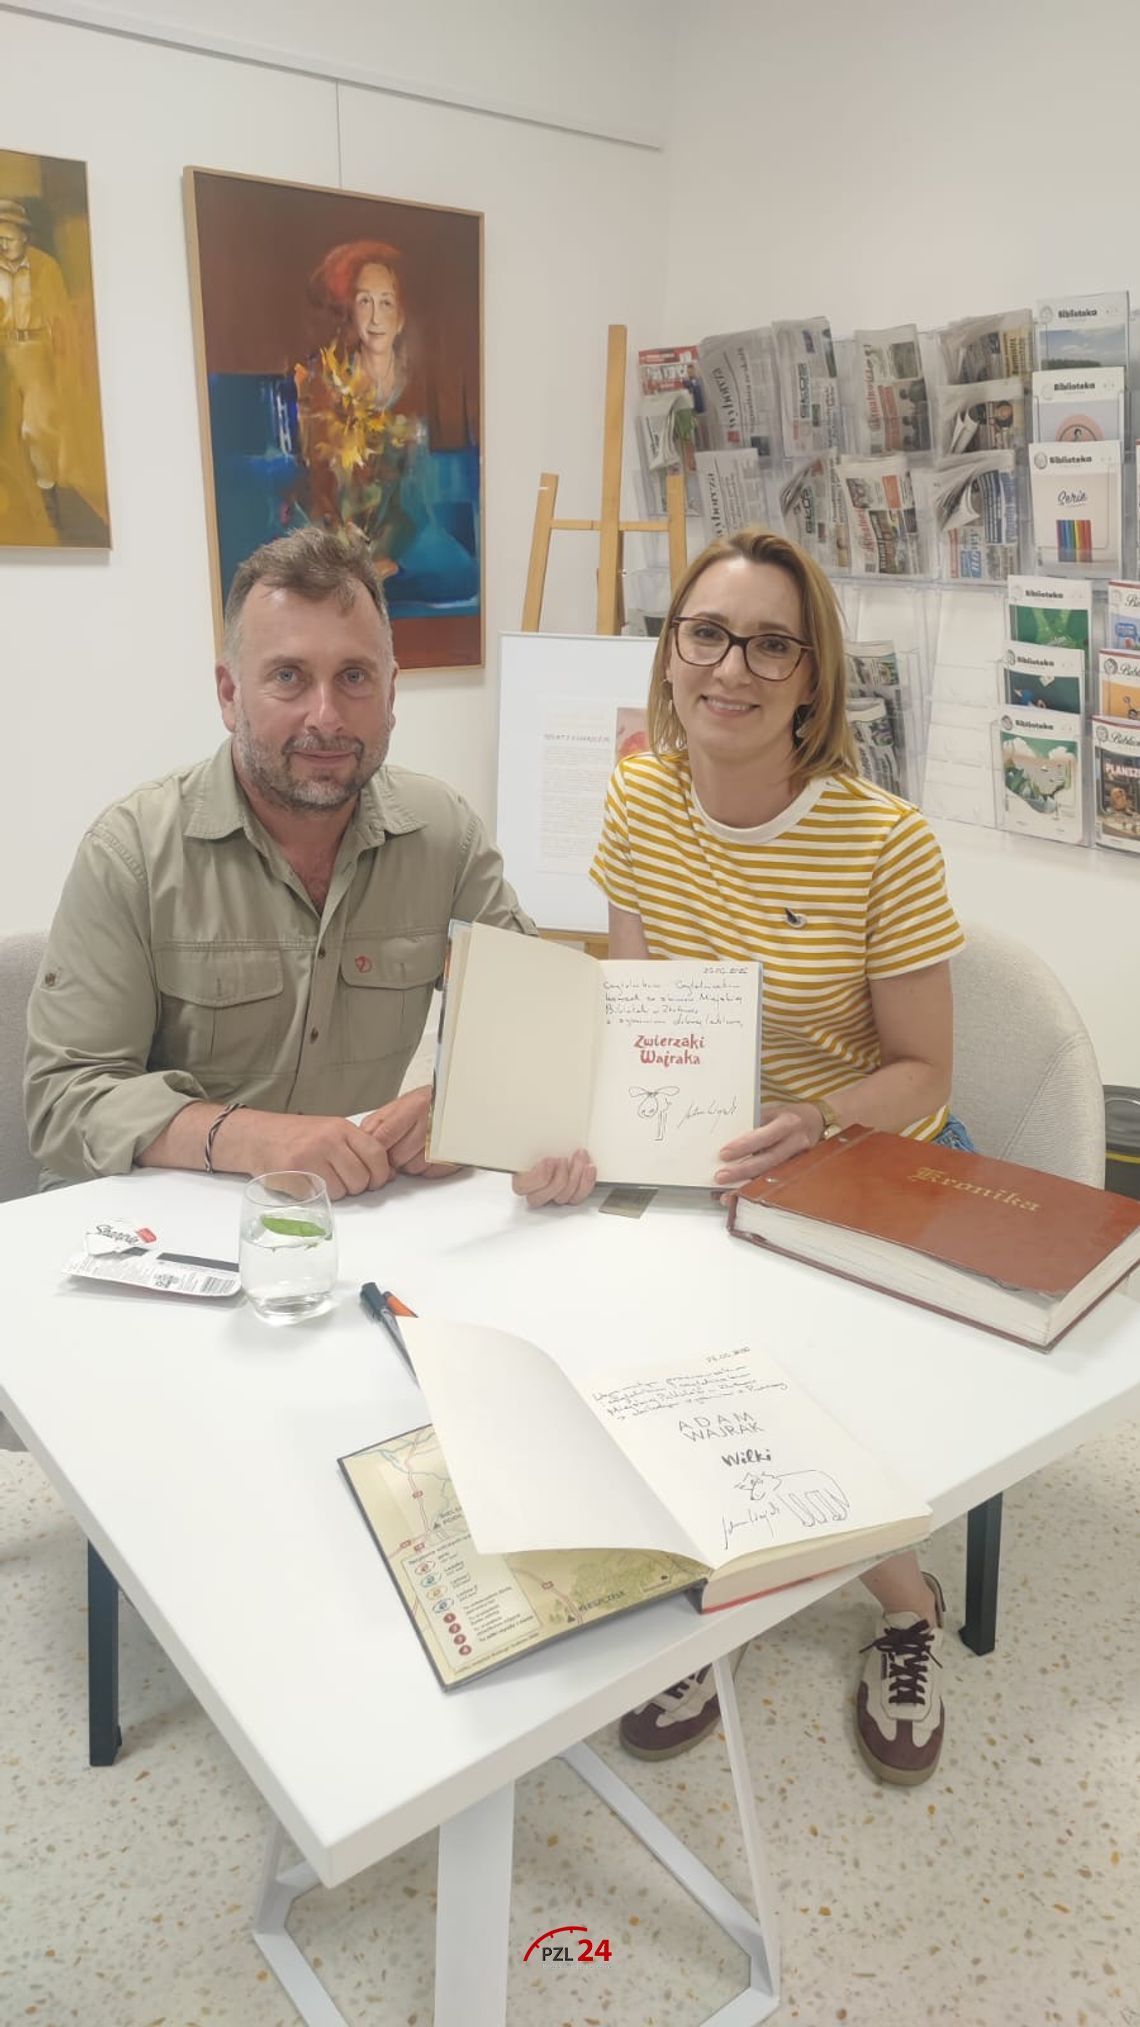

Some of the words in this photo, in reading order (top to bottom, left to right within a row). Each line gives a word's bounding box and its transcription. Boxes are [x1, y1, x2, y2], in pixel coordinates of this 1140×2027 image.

[634, 1034, 705, 1049] Zwierzaki
[639, 1050, 701, 1068] Wajraka
[906, 1166, 1041, 1212] Kronika
[679, 1411, 754, 1431] ADAM
[683, 1421, 765, 1442] WAJRAK
[722, 1449, 772, 1467] Wilki
